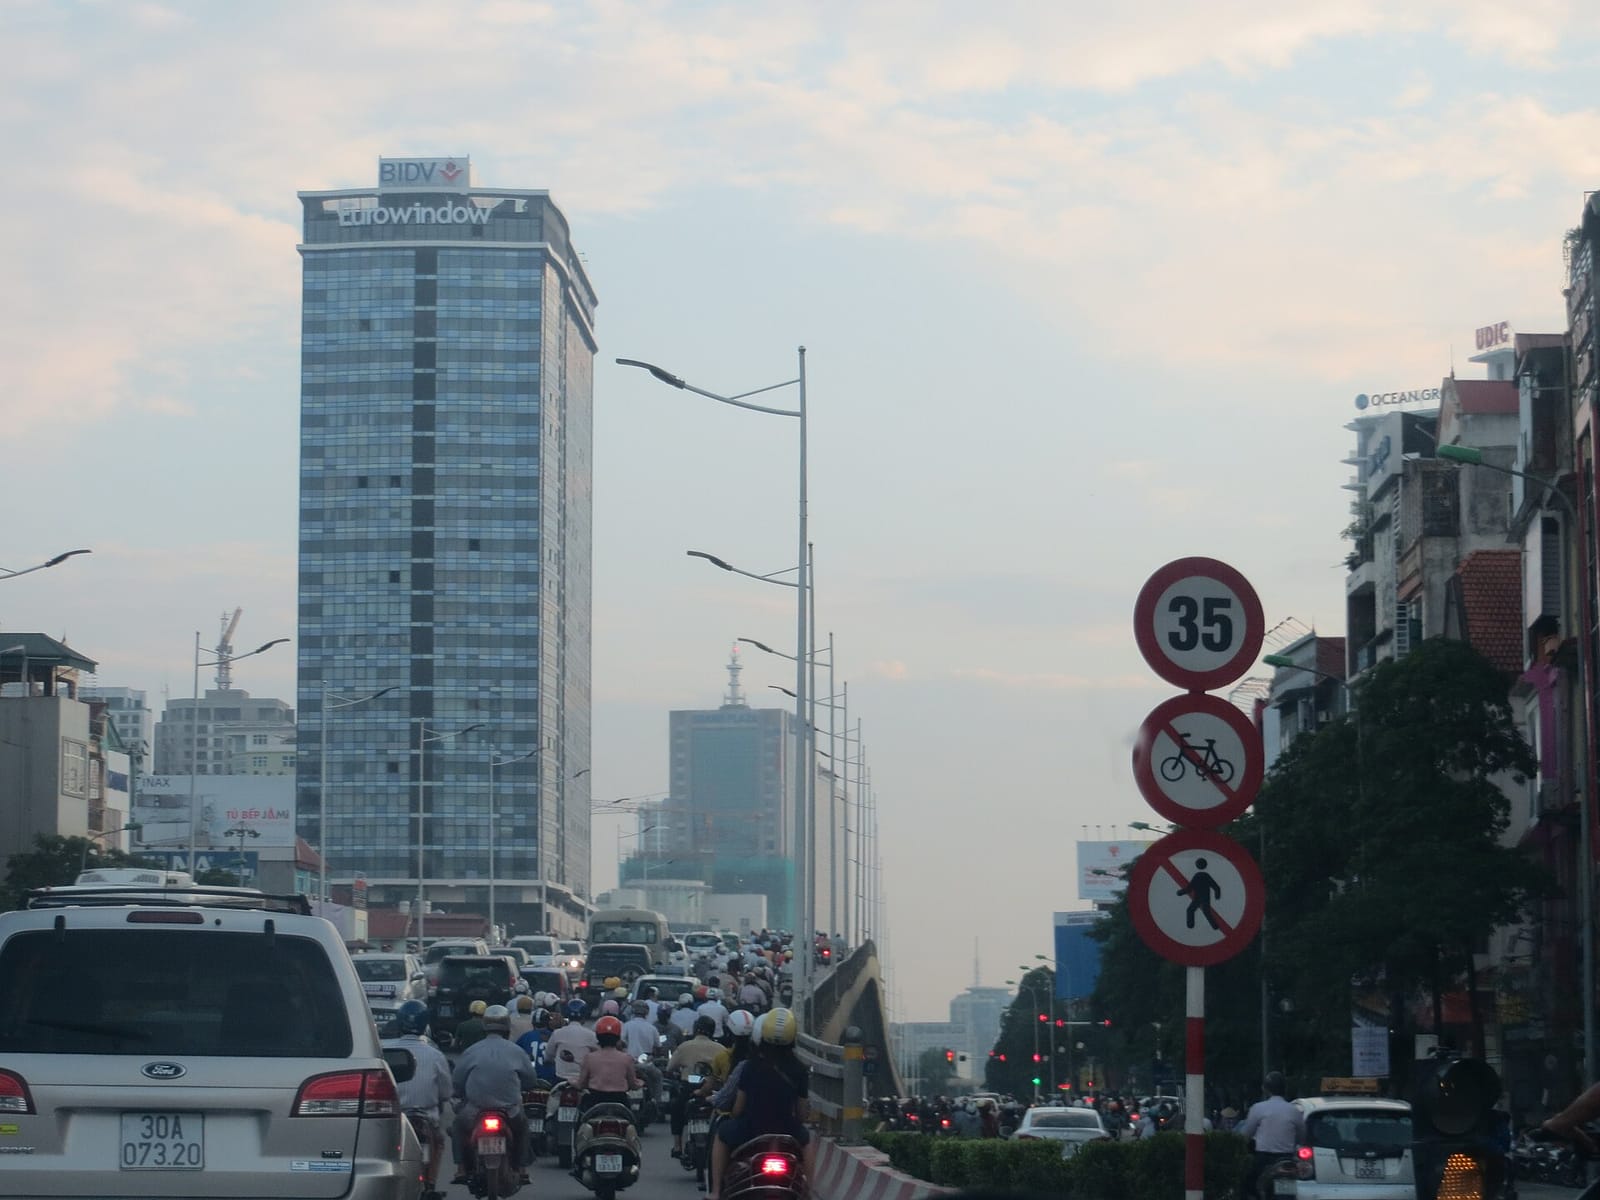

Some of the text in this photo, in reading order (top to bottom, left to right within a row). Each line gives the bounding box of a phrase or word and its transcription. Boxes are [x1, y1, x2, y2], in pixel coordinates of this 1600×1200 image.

[380, 162, 437, 182] BIDV
[338, 201, 492, 226] Eurowindow
[1476, 321, 1509, 350] UDIC
[1371, 391, 1420, 406] OCEAN
[1168, 595, 1232, 652] 35
[151, 1065, 175, 1075] Ford
[141, 1115, 183, 1139] 30A
[124, 1142, 200, 1166] 073.20
